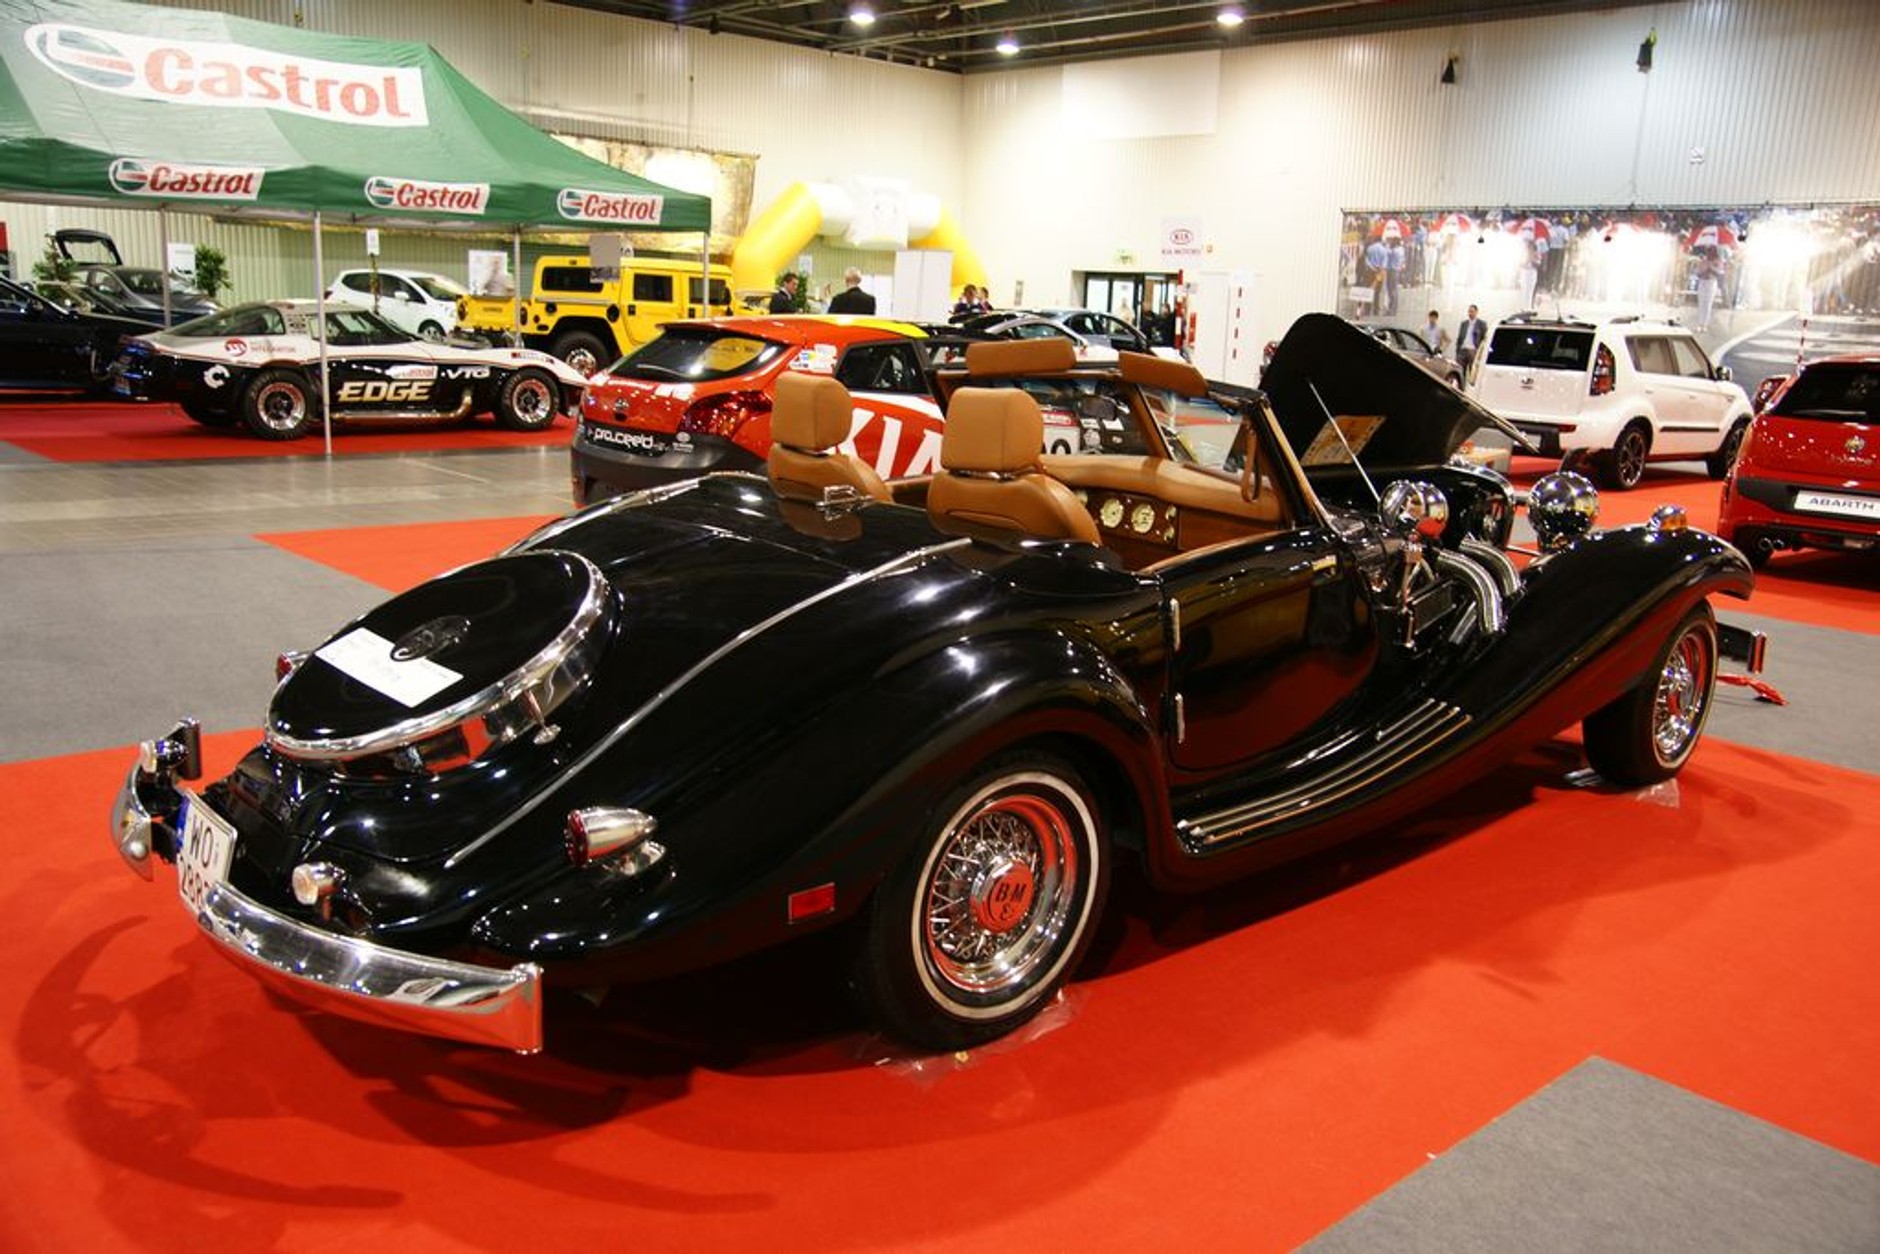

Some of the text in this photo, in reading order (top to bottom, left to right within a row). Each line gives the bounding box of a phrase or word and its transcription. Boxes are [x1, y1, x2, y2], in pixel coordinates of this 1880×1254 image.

[144, 47, 411, 118] Castrol
[149, 166, 254, 194] Castrol
[397, 183, 480, 208] Castrol
[584, 194, 656, 219] Castrol
[444, 366, 490, 379] VTG
[337, 381, 434, 402] EDGE
[1810, 498, 1875, 509] ABARTH
